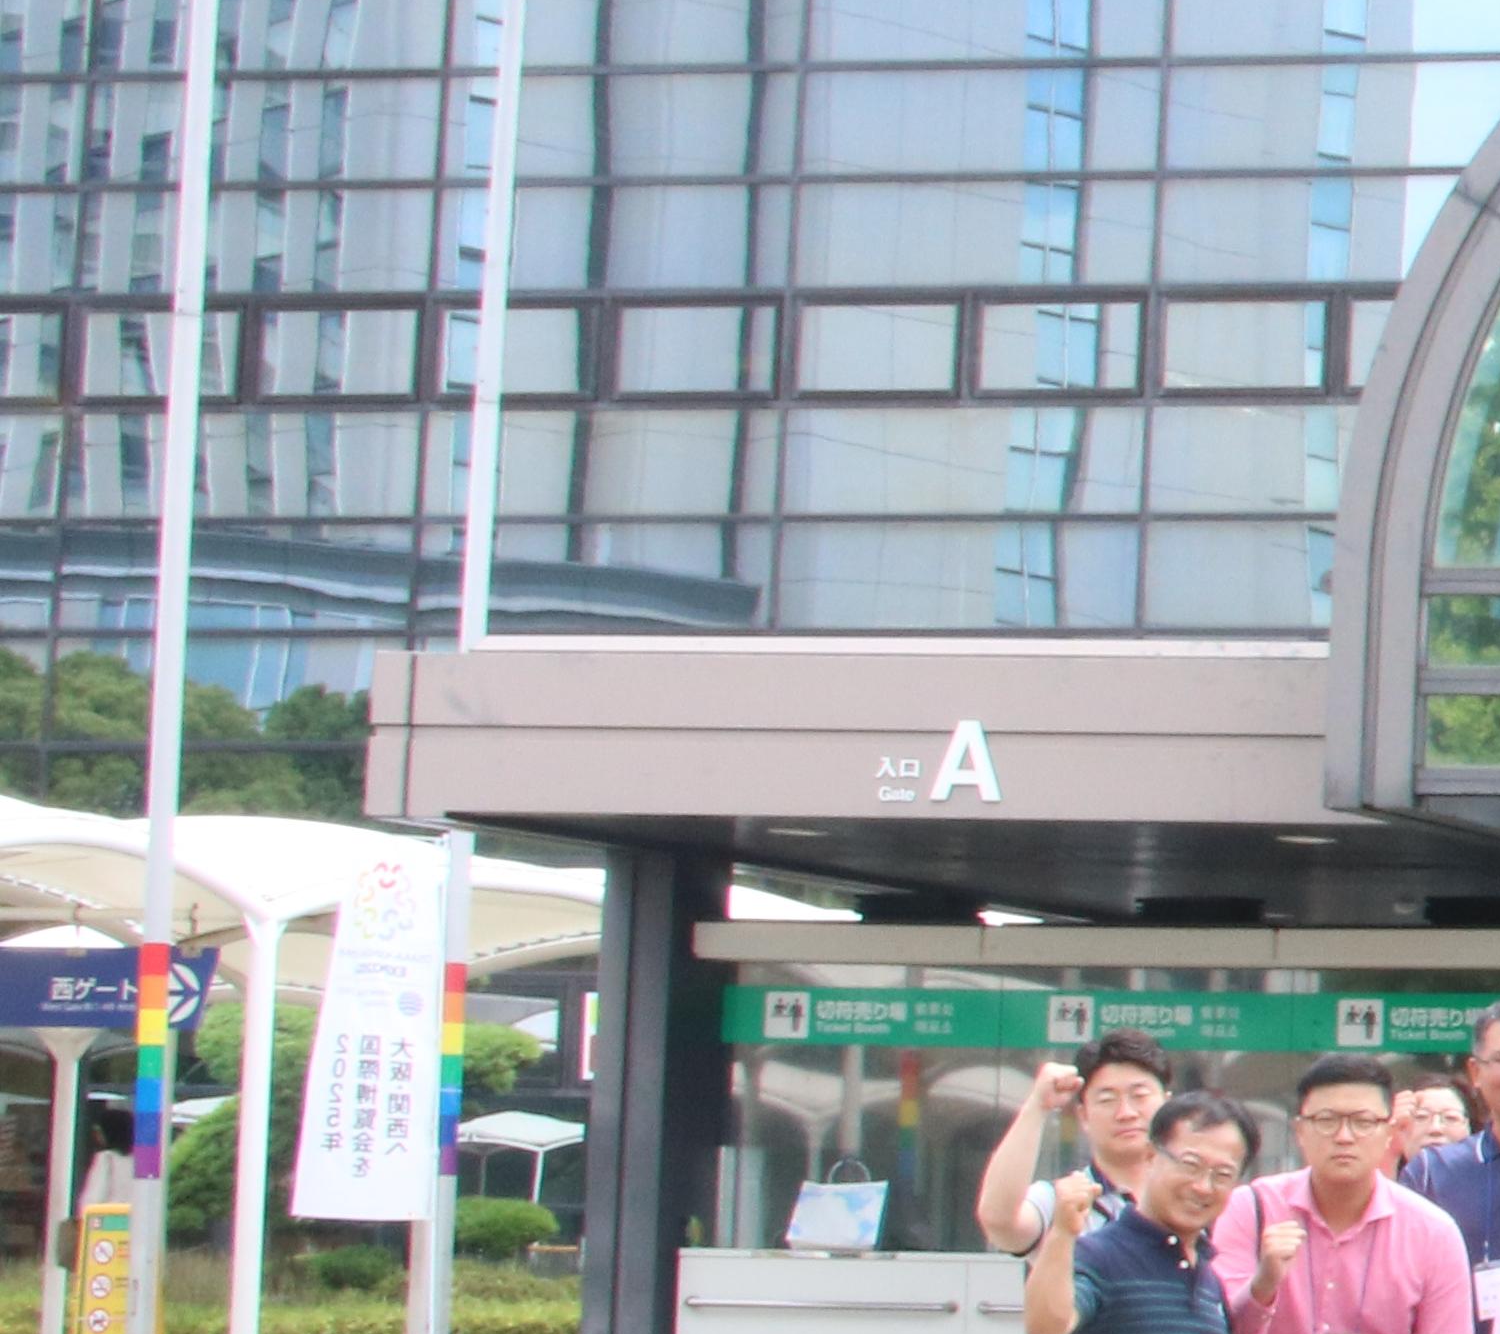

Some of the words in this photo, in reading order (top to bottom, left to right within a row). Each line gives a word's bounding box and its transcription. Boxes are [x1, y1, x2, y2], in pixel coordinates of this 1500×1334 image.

[875, 757, 921, 778] 入口
[929, 719, 1001, 802] A
[878, 786, 916, 802] Gate
[51, 977, 138, 1001] 西ゲート
[815, 1000, 908, 1022] 切符売り場
[1100, 1005, 1193, 1027] 切符売り場
[1390, 1028, 1426, 1041] Ticket
[1429, 1029, 1467, 1041] Booth
